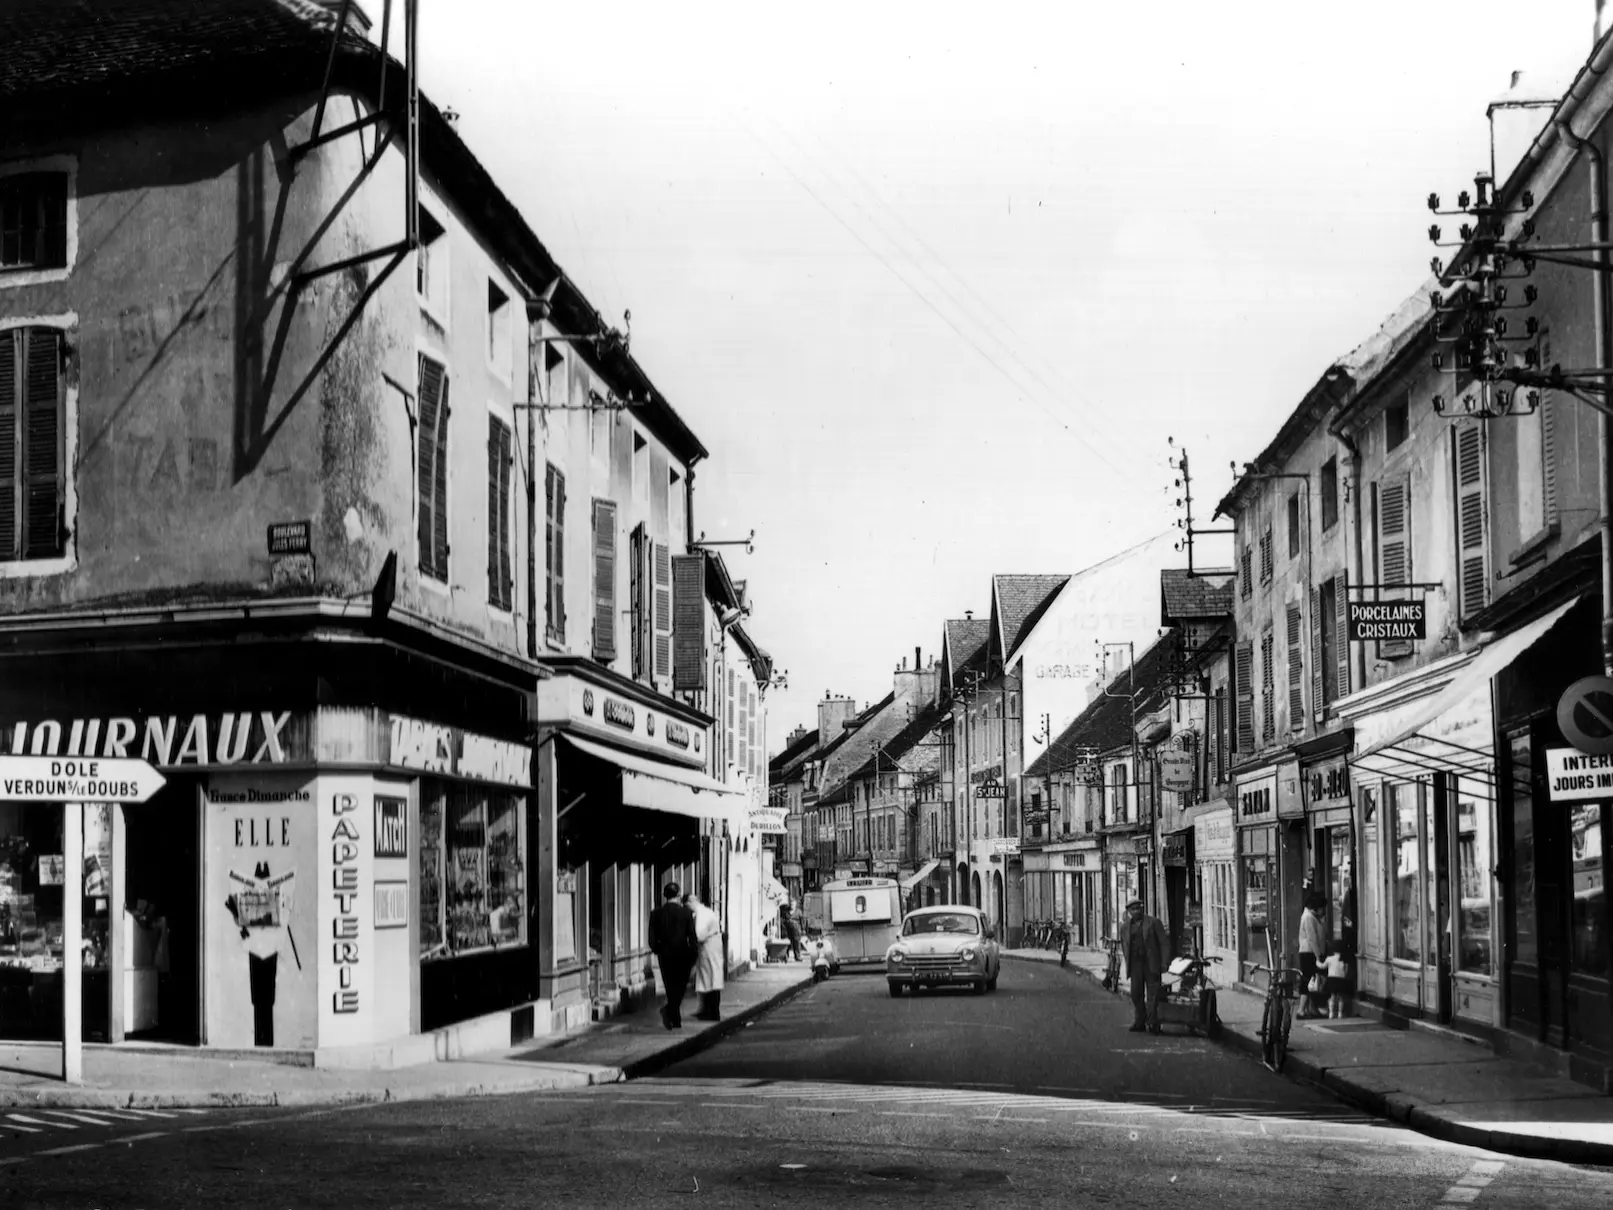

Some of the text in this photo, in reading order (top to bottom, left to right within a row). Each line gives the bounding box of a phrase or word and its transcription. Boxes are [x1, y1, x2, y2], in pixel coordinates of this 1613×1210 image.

[1351, 605, 1422, 620] PORCELAINES
[1357, 622, 1417, 638] CRISTAUX
[1035, 664, 1091, 679] GARAGE
[12, 711, 291, 765] JOURNAUX
[51, 761, 98, 777] DOLE
[1563, 754, 1613, 771] INTER
[4, 779, 66, 795] VERDUN
[87, 780, 138, 797] DOUBS
[1554, 773, 1613, 791] JOURS IM
[986, 787, 1005, 797] JEAN
[235, 817, 290, 847] ELLE
[375, 800, 405, 853] MATCH
[332, 793, 359, 1014] PAPETERIE
